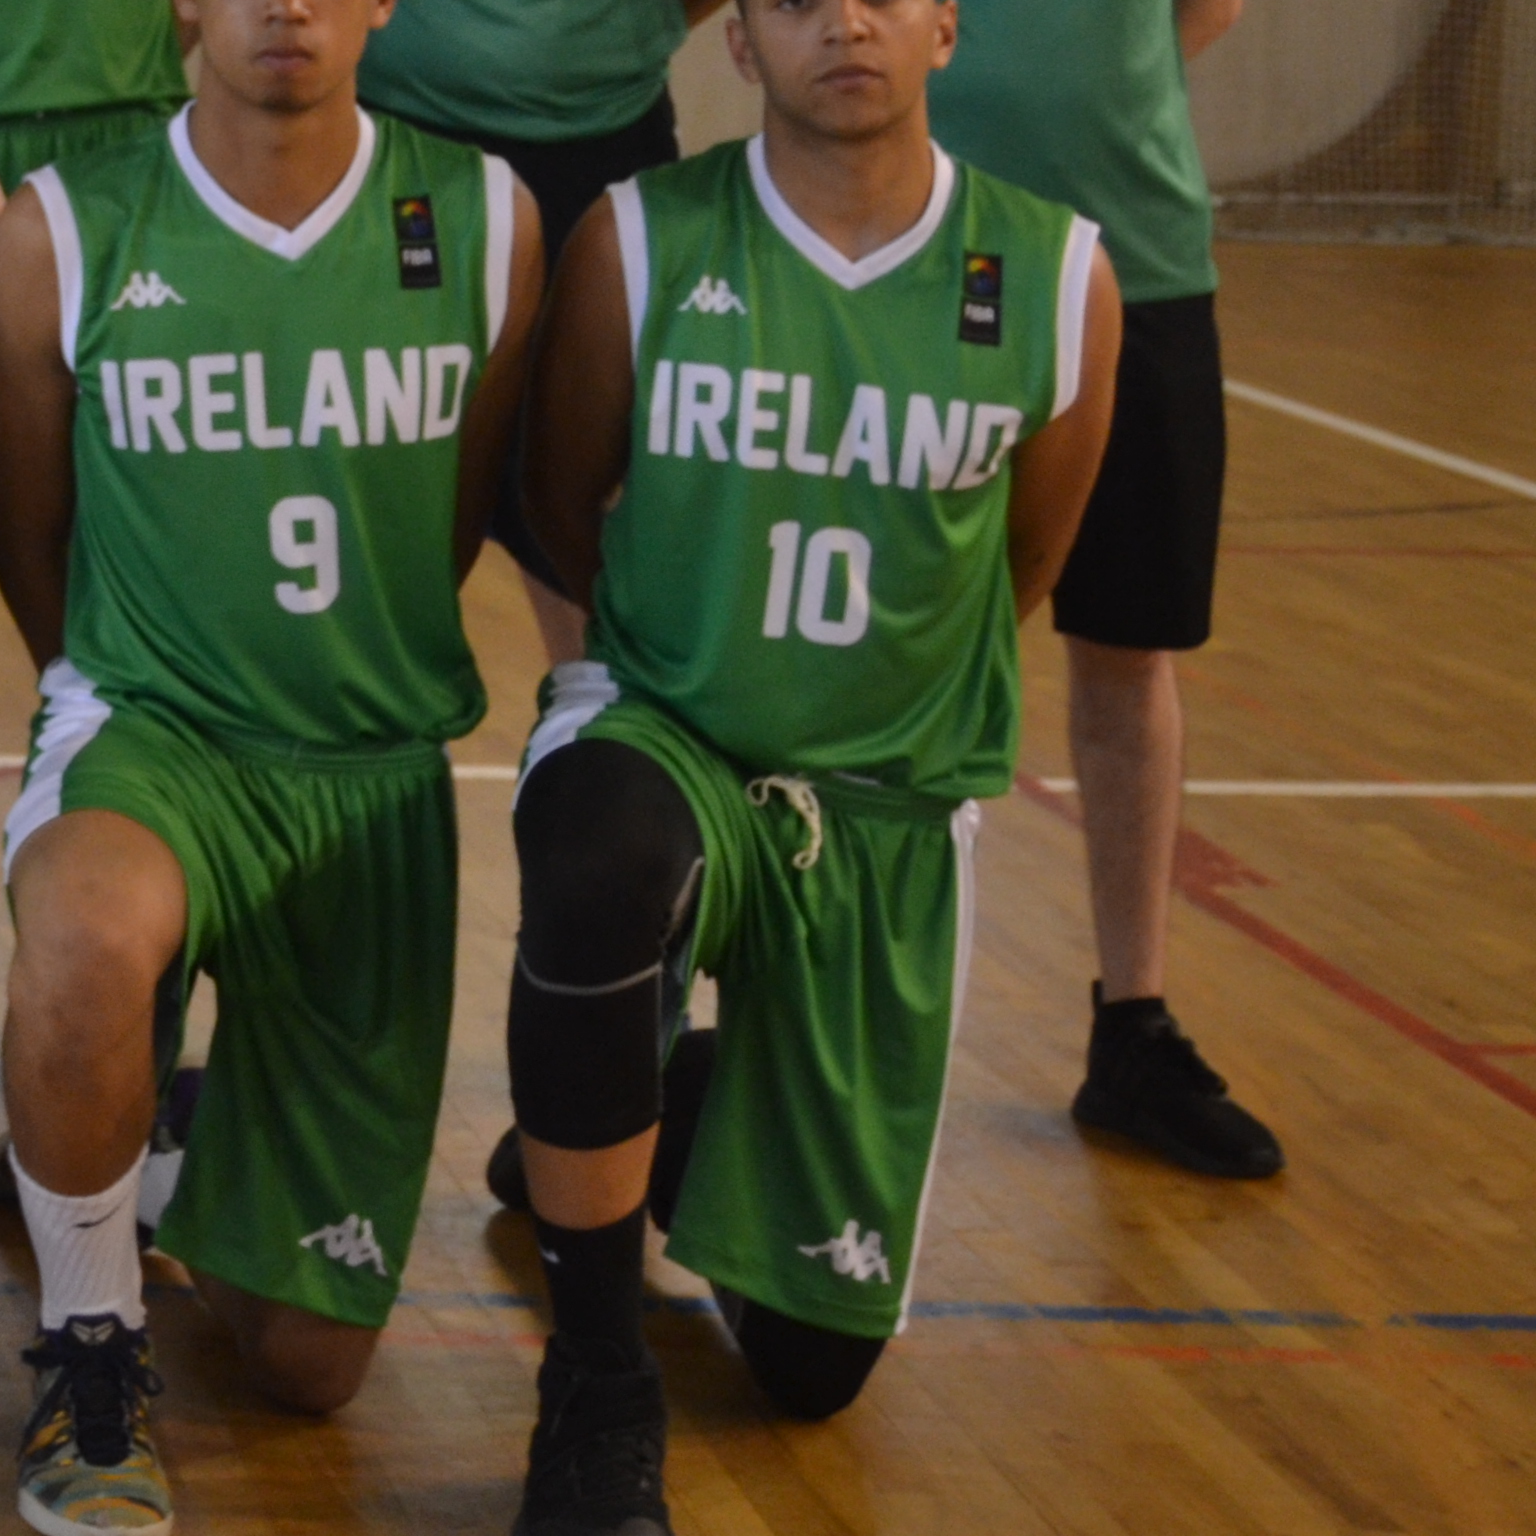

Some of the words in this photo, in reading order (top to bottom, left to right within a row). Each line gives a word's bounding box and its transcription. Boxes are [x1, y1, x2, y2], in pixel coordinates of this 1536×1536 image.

[99, 343, 473, 454] IRELAND
[647, 358, 1024, 491] IRELAND
[269, 494, 341, 614] 9
[762, 519, 872, 647] 10
